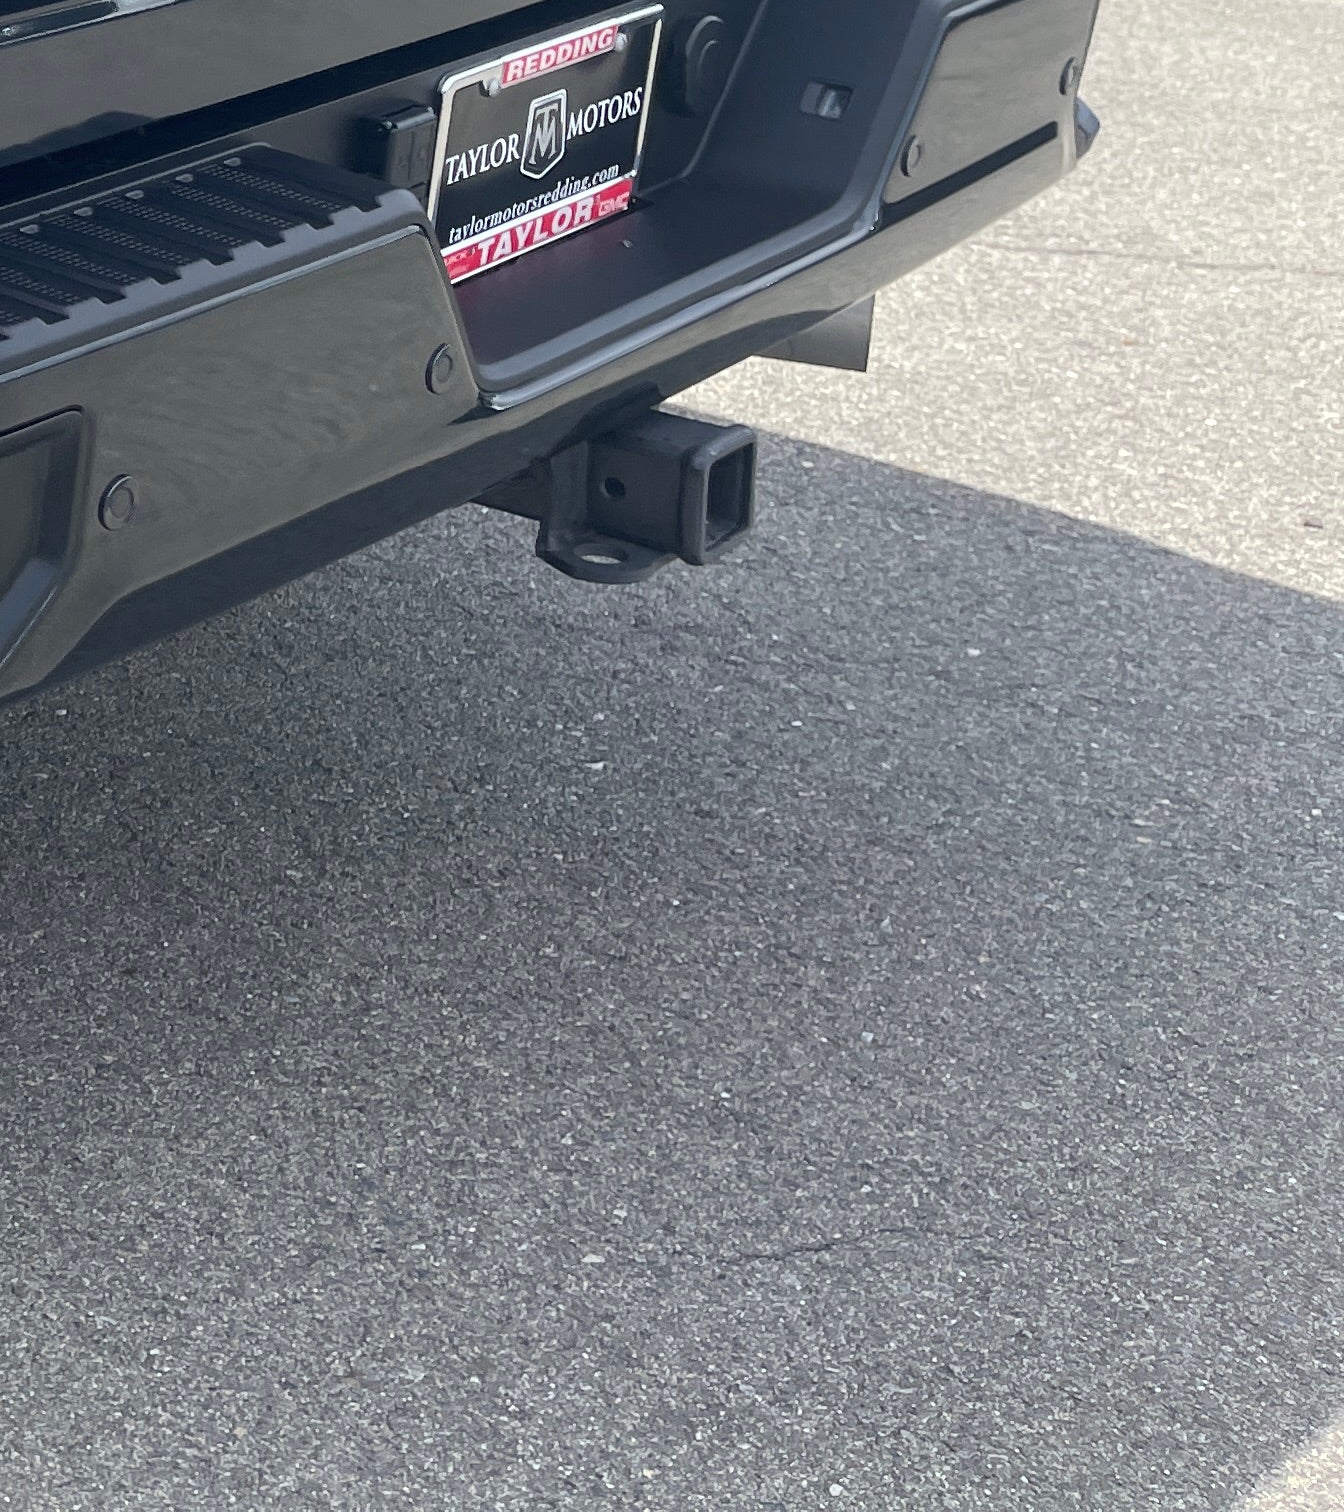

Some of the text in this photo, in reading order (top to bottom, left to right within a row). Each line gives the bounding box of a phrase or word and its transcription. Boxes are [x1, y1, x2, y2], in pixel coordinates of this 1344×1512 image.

[505, 28, 616, 82] REDDING
[445, 133, 520, 186] TAYLOR
[567, 87, 643, 140] MOTORS
[448, 164, 619, 244] taylormotorsredding.com
[477, 197, 594, 266] TAYLOR
